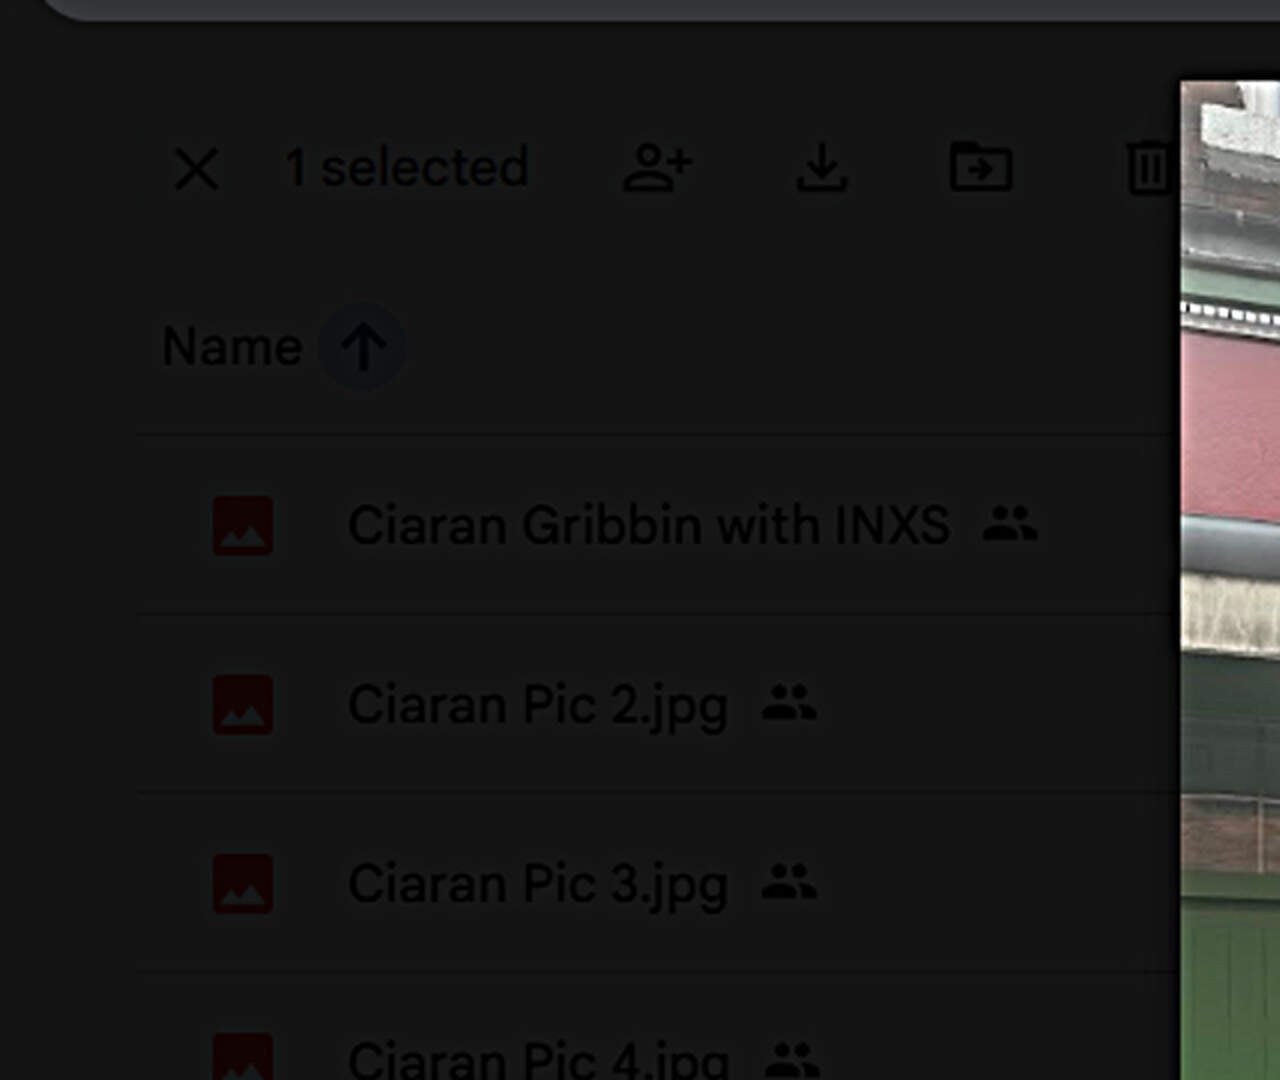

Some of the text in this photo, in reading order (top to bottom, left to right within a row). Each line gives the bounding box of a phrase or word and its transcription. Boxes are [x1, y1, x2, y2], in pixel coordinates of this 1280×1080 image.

[287, 144, 527, 186] 1 selected
[165, 326, 302, 365] Name
[350, 502, 949, 544] Ciaran Gribbin with INXS
[350, 681, 727, 736] Ciaran Pic 2.jpg
[350, 860, 727, 914] Ciaran Pic 3.jpg
